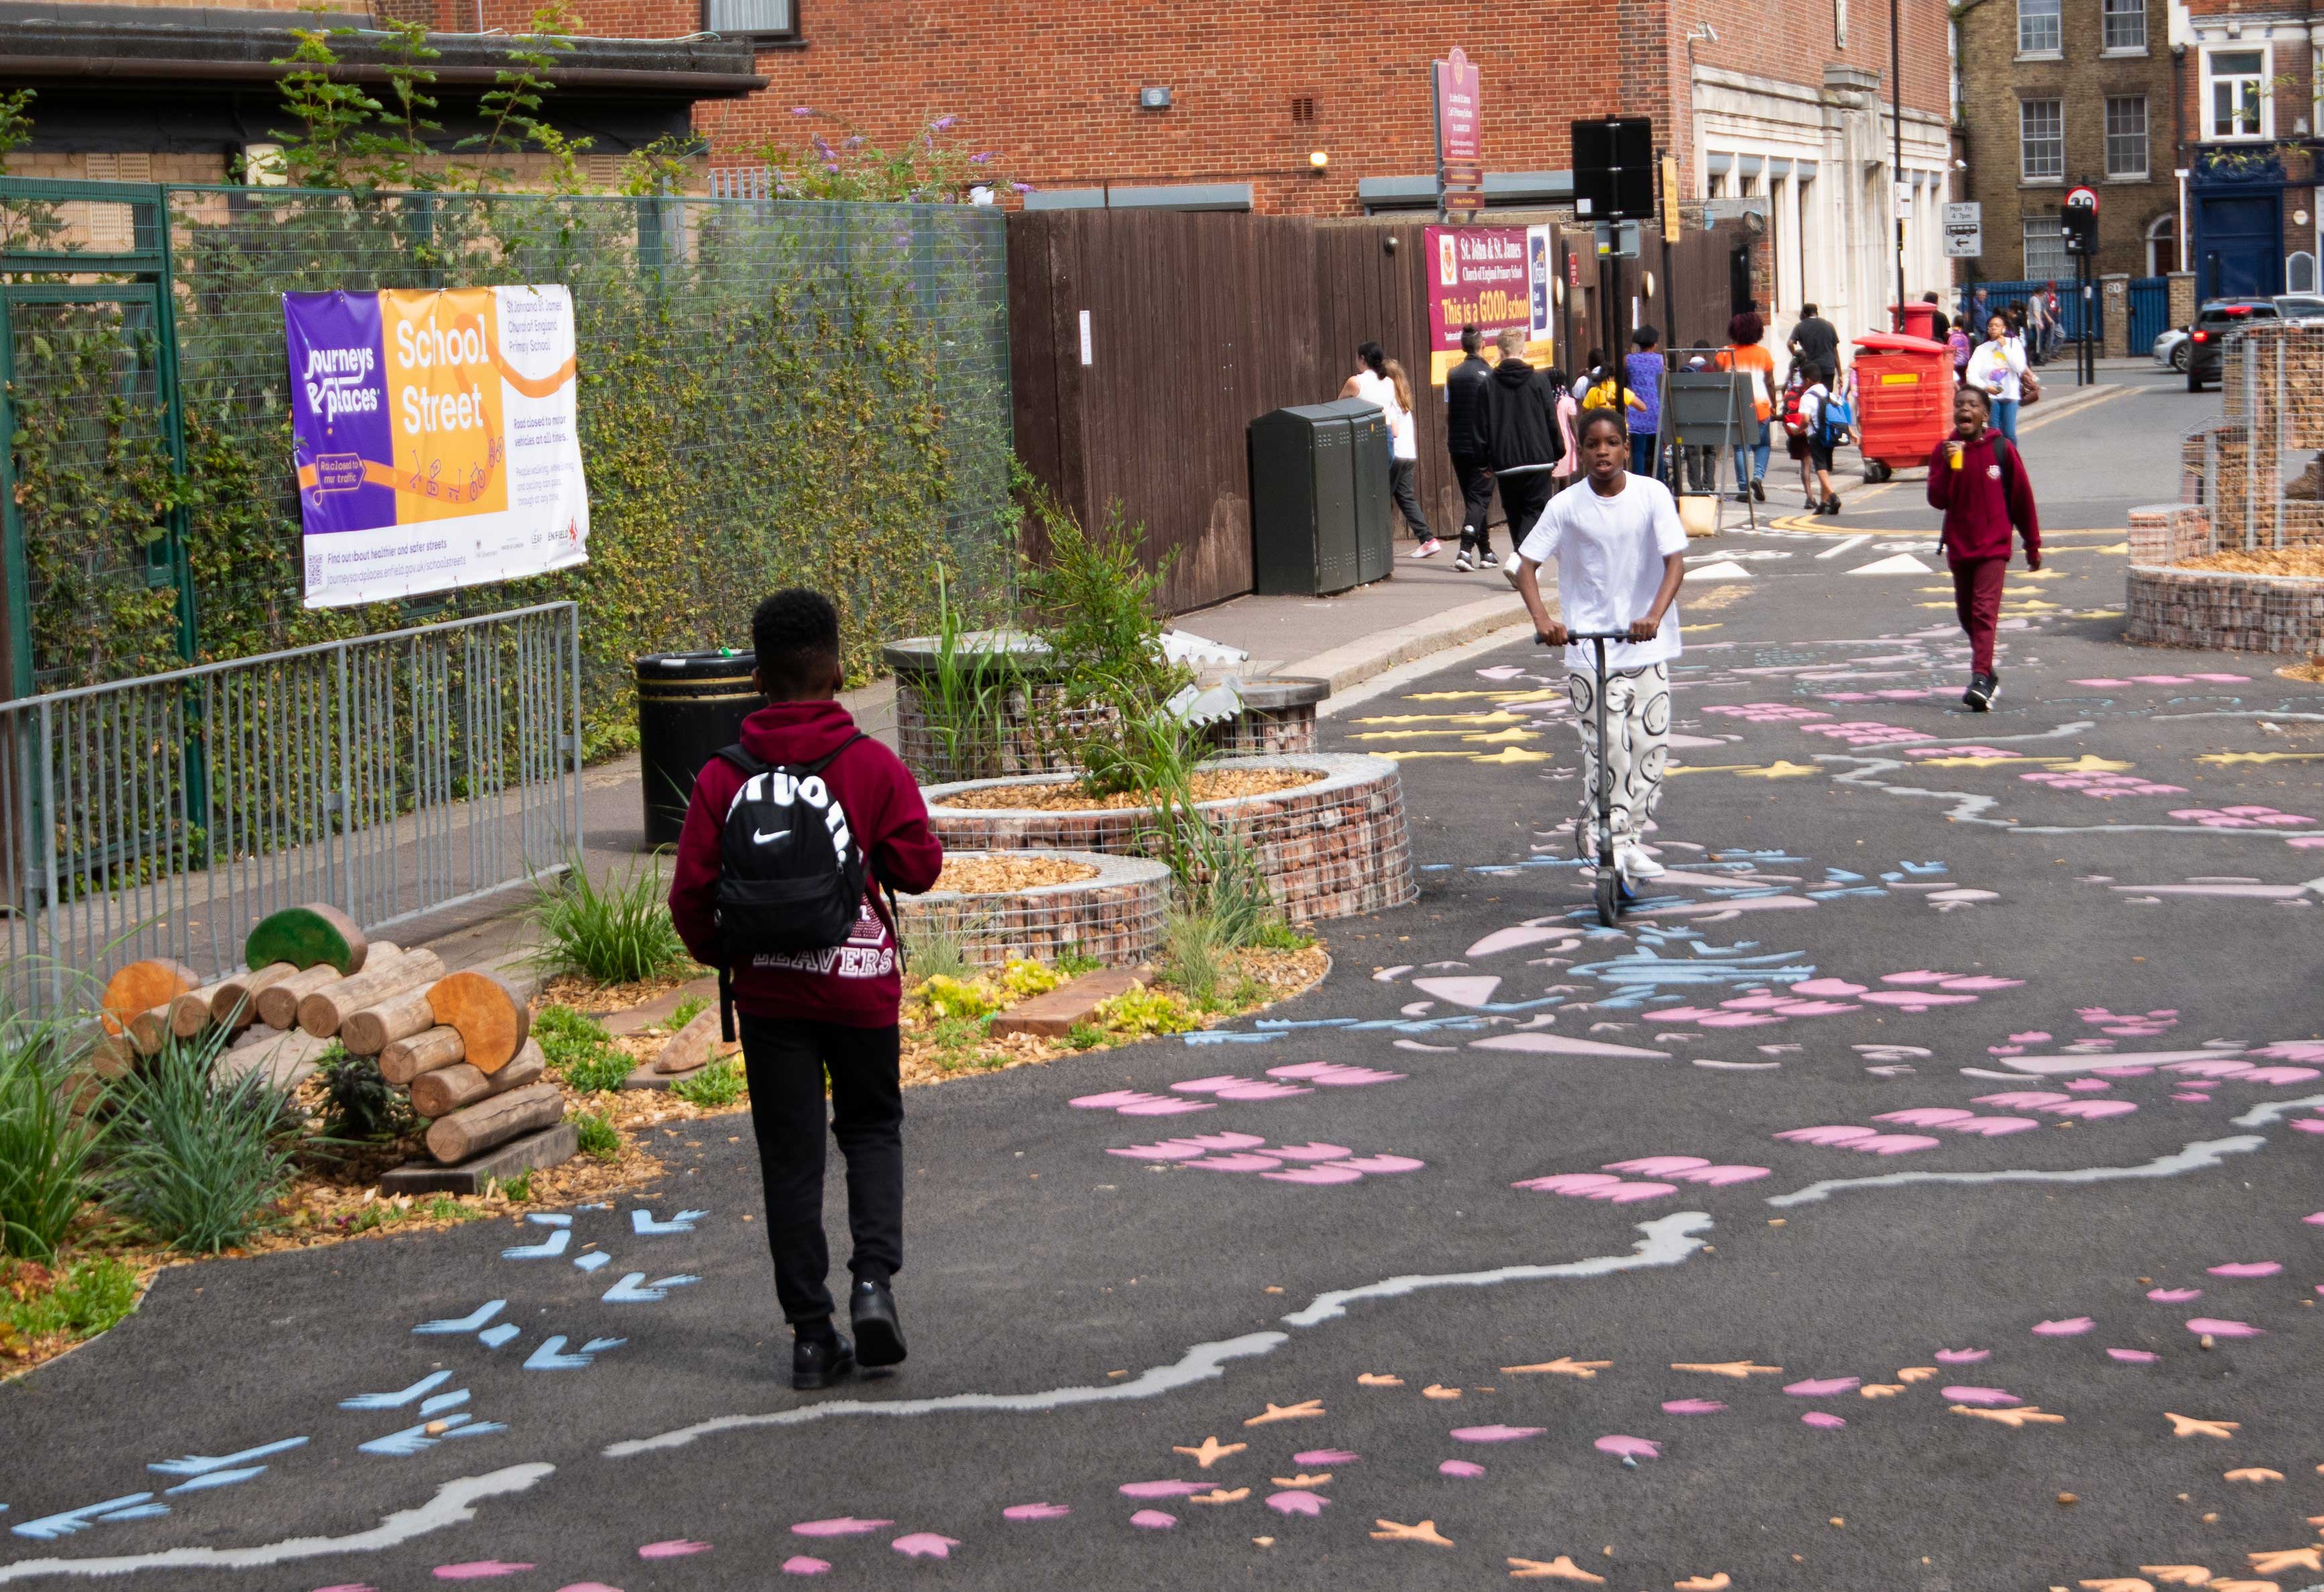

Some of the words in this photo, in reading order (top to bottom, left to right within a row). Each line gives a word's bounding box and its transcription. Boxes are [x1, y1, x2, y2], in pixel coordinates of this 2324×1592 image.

[1472, 237, 1487, 260] John
[1488, 237, 1494, 259] &
[1503, 237, 1521, 259] James
[545, 299, 563, 311] James
[1441, 297, 1461, 325] This
[1463, 297, 1471, 323] is
[1473, 302, 1478, 323] a
[1479, 290, 1506, 322] GOOD
[1508, 292, 1529, 319] school
[535, 318, 557, 335] England
[396, 313, 489, 368] School
[531, 338, 551, 351] School
[305, 347, 374, 382] journeys
[327, 378, 378, 422] places
[402, 383, 484, 435] Street
[527, 415, 545, 427] closed
[548, 530, 569, 541] ENFIELD
[328, 553, 341, 564] Find
[371, 545, 396, 559] healthier
[397, 543, 408, 555] and
[410, 541, 425, 553] safer
[427, 539, 447, 551] streets
